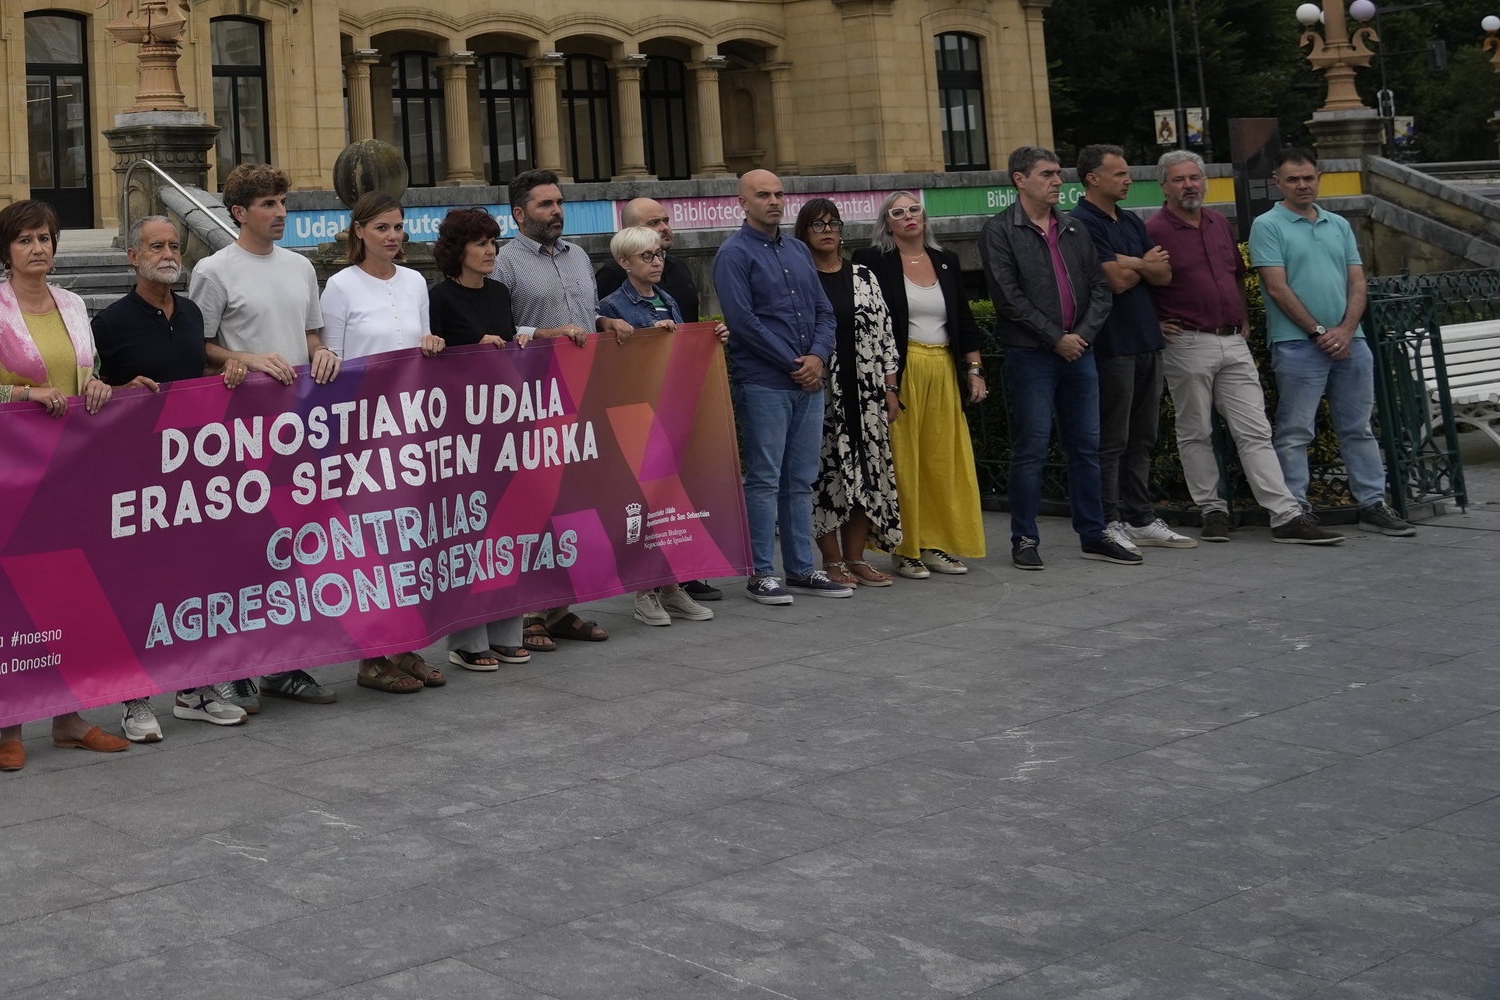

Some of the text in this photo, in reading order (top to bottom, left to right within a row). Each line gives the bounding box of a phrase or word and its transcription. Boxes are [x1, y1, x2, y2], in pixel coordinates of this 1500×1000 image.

[161, 377, 564, 473] DONOSTIAKO UDALA
[111, 421, 599, 539] ERASO SEXISTEN AURKA
[266, 489, 487, 571] CONTRA LAS
[145, 529, 578, 649] AGRESIONES SEXISTAS
[11, 628, 62, 647] #noesno
[11, 652, 62, 673] Donostia
